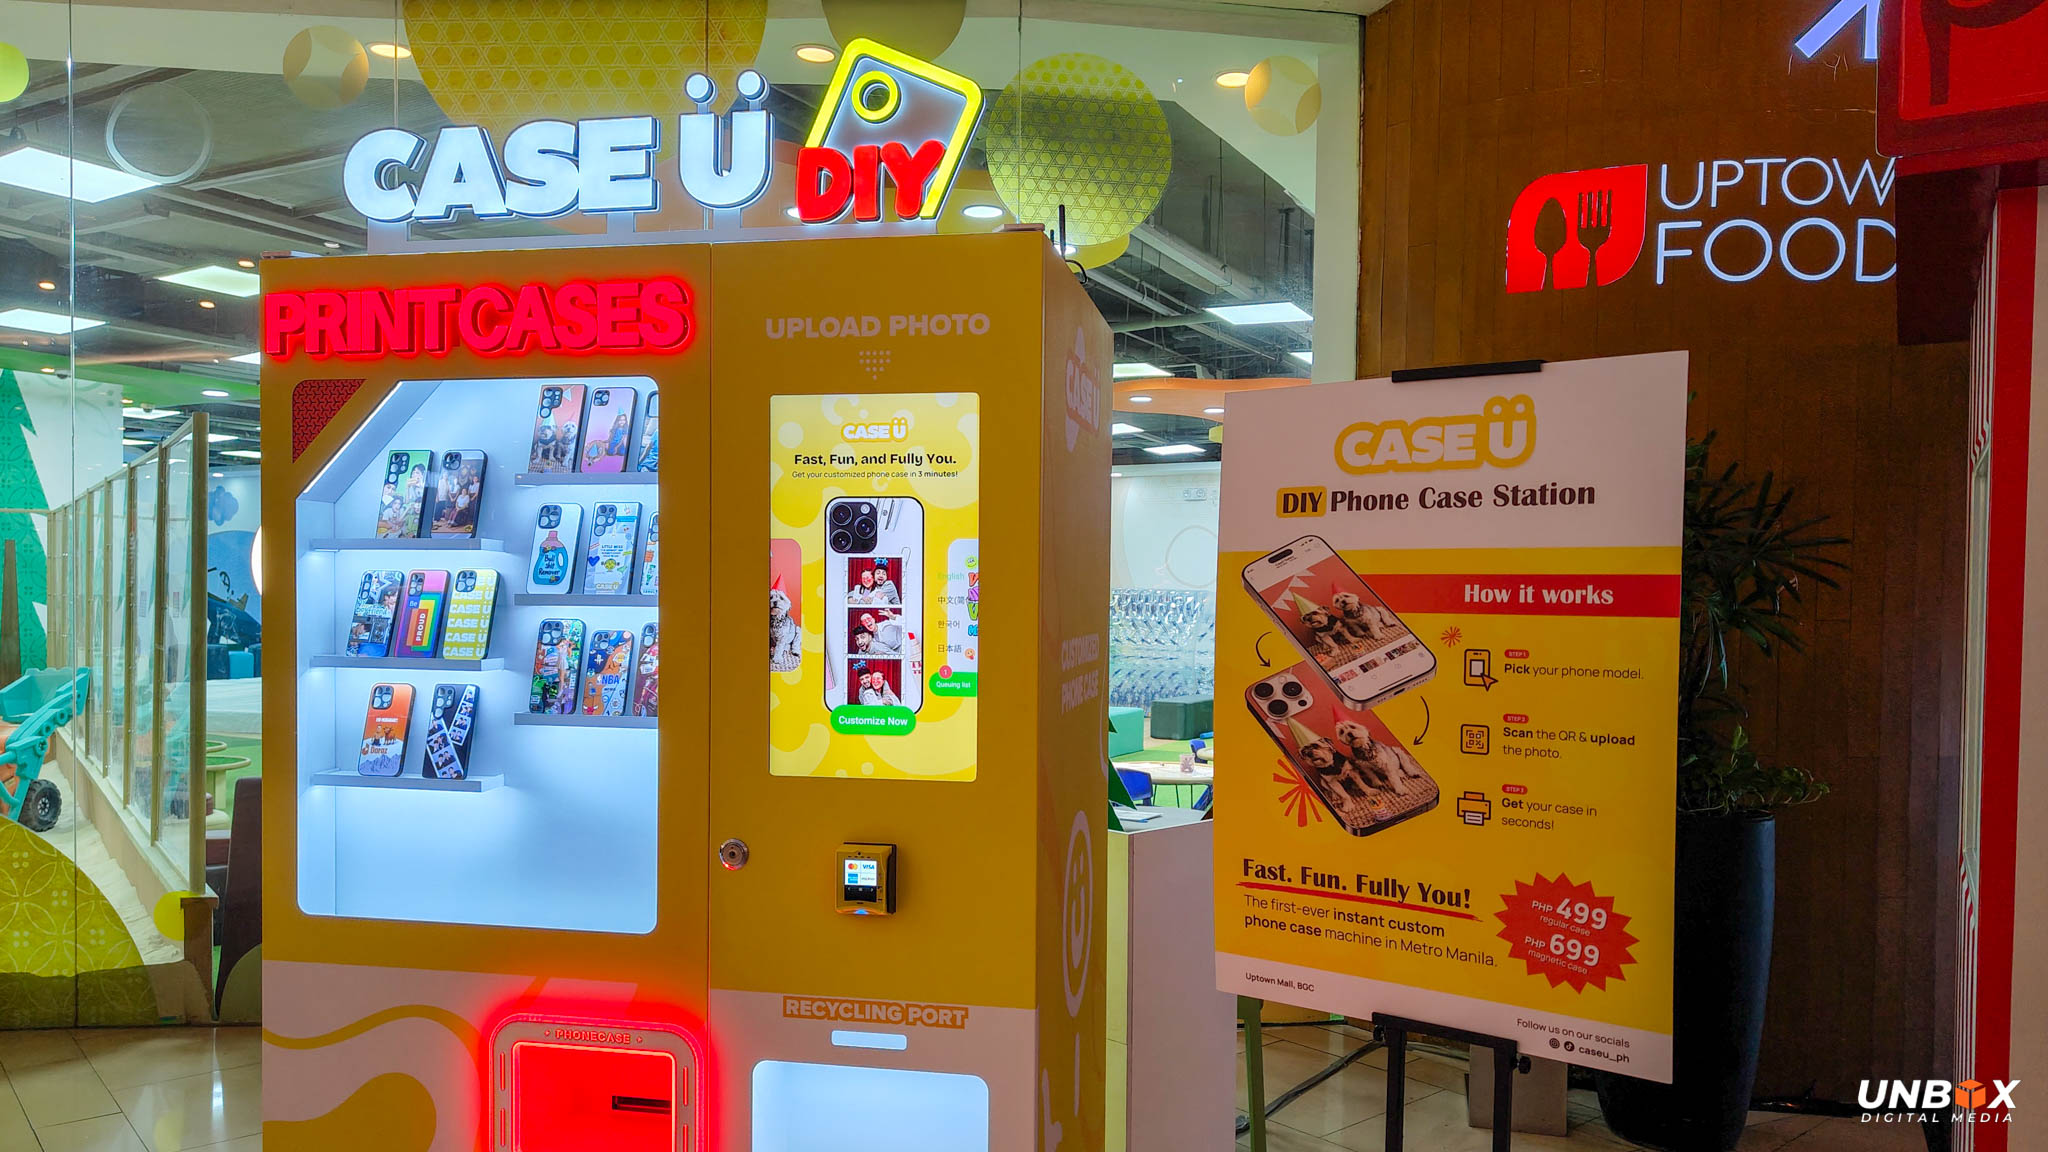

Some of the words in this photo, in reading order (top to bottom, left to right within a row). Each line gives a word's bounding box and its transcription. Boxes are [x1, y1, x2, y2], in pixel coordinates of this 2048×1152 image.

[343, 116, 658, 222] CASE
[679, 69, 774, 209] Ü
[795, 139, 945, 224] DIY
[1656, 217, 1897, 285] FOOD
[265, 287, 459, 357] PRINT
[458, 280, 689, 351] CASES
[766, 316, 881, 339] UPLOAD
[889, 313, 991, 337] PHOTO
[1066, 358, 1092, 424] CASE
[843, 424, 890, 440] CASE
[892, 417, 908, 440] Ü
[1341, 424, 1476, 468] CASE
[1488, 402, 1528, 460] Ü
[794, 454, 827, 467] Fast,
[829, 454, 858, 467] Fun,
[861, 453, 886, 465] and
[890, 453, 923, 467] Fully
[926, 453, 957, 465] You.
[805, 472, 822, 480] your
[823, 470, 866, 479] customized
[866, 470, 889, 480] phone
[910, 470, 917, 478] in
[924, 470, 959, 478] minutes!
[1282, 490, 1323, 514] DIY
[1330, 490, 1410, 512] Phone
[1419, 487, 1483, 509] Case
[1493, 481, 1596, 507] Station
[937, 572, 965, 582] English
[1464, 584, 1512, 603] How
[1519, 584, 1535, 603] it
[1542, 585, 1614, 604] works
[450, 604, 480, 614] CASE
[415, 613, 426, 641] PROUD
[447, 618, 478, 628] CASE
[937, 620, 960, 630] 한국어
[445, 632, 475, 642] CASE
[443, 646, 473, 656] CASE
[937, 644, 962, 653] 日本語
[601, 675, 620, 684] NBA
[1504, 663, 1530, 675] Pick
[1532, 665, 1559, 677] your
[1561, 665, 1600, 679] phone
[1602, 668, 1644, 679] model.
[936, 681, 960, 690] Queuing
[1061, 674, 1083, 715] PHONE
[1084, 669, 1099, 700] CASE
[838, 716, 886, 726] Customize
[887, 717, 908, 726] Now
[1503, 727, 1533, 738] Scan
[1536, 728, 1556, 741] the
[1558, 730, 1576, 742] QR
[1579, 731, 1587, 742] &
[1590, 733, 1635, 747] upload
[1502, 744, 1522, 756] the
[1524, 746, 1563, 759] photo.
[1501, 798, 1524, 809] Get
[1526, 801, 1552, 813] your
[1555, 803, 1584, 815] case
[1586, 805, 1597, 816] in
[1501, 816, 1555, 830] seconds!
[1243, 858, 1292, 883] Fast.
[1300, 866, 1347, 891] Fun.
[1356, 874, 1411, 904] Fully
[1417, 882, 1471, 909] You!
[1244, 894, 1268, 910] The
[1271, 898, 1330, 919] first-ever
[1333, 908, 1385, 928] instant
[1388, 917, 1445, 938] custom
[1531, 900, 1553, 914] PHP
[1556, 898, 1608, 930] 499
[1540, 914, 1569, 930] regular
[1570, 925, 1591, 937] case
[1244, 915, 1288, 931] phone
[1290, 923, 1322, 937] case
[1324, 926, 1382, 948] machine
[1385, 935, 1398, 950] in
[1400, 939, 1443, 958] Metro
[1446, 946, 1498, 968] Manila.
[1524, 936, 1546, 949] PHP
[1550, 934, 1600, 967] 699
[1528, 949, 1567, 967] magnetic
[1567, 962, 1588, 975] case
[1246, 972, 1276, 985] Uptown
[1277, 978, 1296, 989] Mall,
[1297, 982, 1315, 992] BGC
[785, 999, 903, 1022] RECYCLING
[908, 1007, 966, 1026] PORT
[555, 1029, 631, 1044] PHONECASE
[1517, 1018, 1547, 1033] Follow
[1548, 1026, 1560, 1035] us
[1562, 1029, 1575, 1038] on
[1576, 1032, 1593, 1041] our
[1595, 1035, 1630, 1049] socials
[1578, 1045, 1630, 1063] caseu_ph
